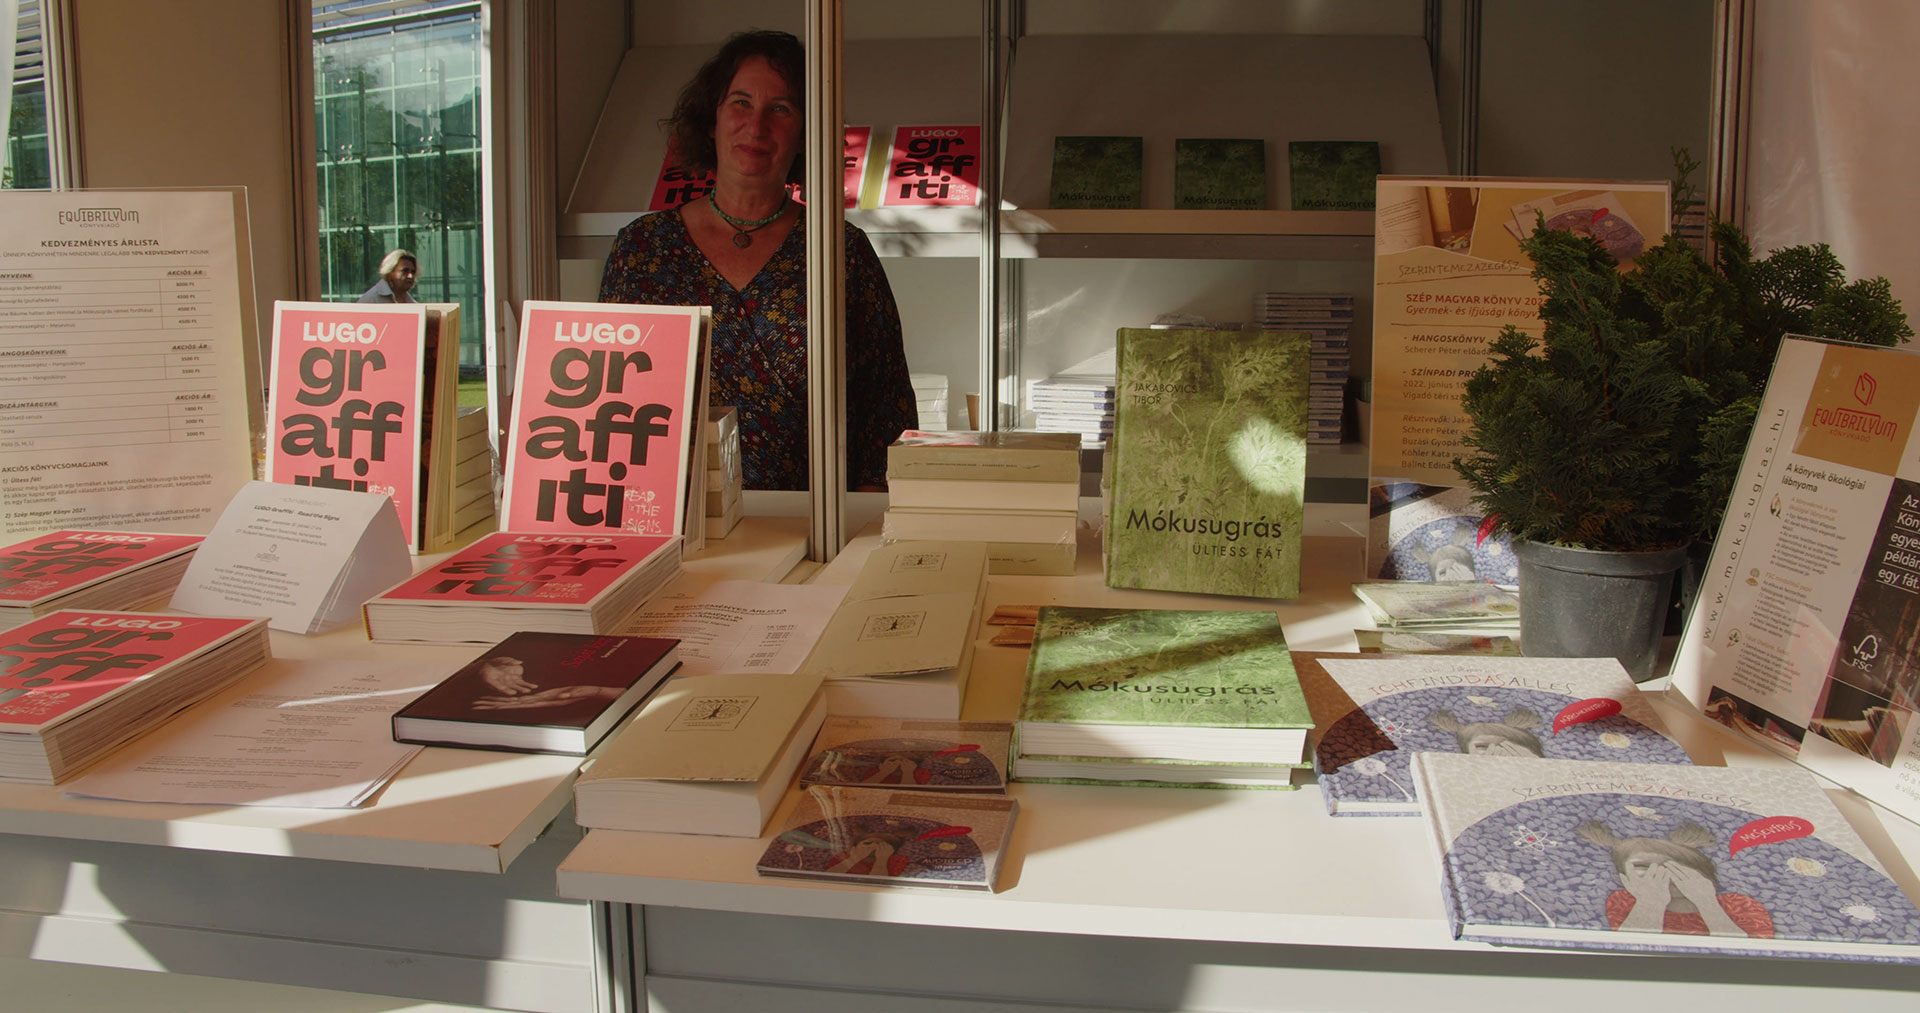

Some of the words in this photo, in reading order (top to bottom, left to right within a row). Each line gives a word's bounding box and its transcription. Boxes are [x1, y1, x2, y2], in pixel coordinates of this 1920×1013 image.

[905, 137, 964, 159] gr
[894, 154, 976, 177] aff
[41, 238, 118, 248] KEDVEZMÉNYES
[121, 237, 160, 246] ÁRLISTA
[1406, 291, 1433, 304] SZÉP
[1435, 294, 1481, 305] MAGYAR
[1483, 293, 1521, 306] KÖNYV
[1406, 305, 1452, 317] Gyermek-
[1455, 306, 1466, 316] és
[1468, 306, 1506, 319] ifjúsági
[1508, 307, 1537, 319] könyv
[1412, 333, 1486, 344] HANGOSKÖNYV
[1404, 345, 1436, 354] Scherer
[1438, 346, 1460, 355] Péter
[295, 347, 387, 407] gr
[544, 347, 653, 409] gr
[1411, 367, 1456, 377] SZÍNPADI
[1134, 382, 1198, 395] JAKABOVICS
[1403, 380, 1426, 388] 2022.
[1427, 380, 1453, 390] június
[1133, 394, 1162, 406] TIBOR
[1403, 391, 1432, 401] Vigadó
[1433, 391, 1449, 400] téri
[1402, 414, 1450, 424] Résztvevők:
[280, 398, 405, 462] aff
[525, 400, 673, 466] aff
[1402, 425, 1434, 434] Scherer
[1436, 426, 1459, 435] Péter
[1402, 437, 1429, 446] Buzási
[1431, 437, 1460, 447] Gyopár
[1402, 449, 1429, 458] Köhler
[1431, 450, 1450, 458] Kata
[2, 464, 30, 473] AKCIÓS
[31, 461, 109, 471] KÖNYVCSOMAGJAINK
[1401, 460, 1426, 469] Bálint
[1428, 461, 1451, 469] Edina
[1786, 463, 1793, 472] A
[1794, 464, 1827, 482] könyvek
[1827, 472, 1867, 491] ökológiai
[1781, 475, 1819, 494] lábnyoma
[536, 461, 628, 529] iti
[624, 490, 656, 502] READ
[1902, 494, 1919, 509] Az
[635, 505, 660, 517] THE
[1125, 508, 1283, 542] Mókusugrás
[1897, 511, 1920, 533] Kön
[1192, 543, 1248, 558] ÜLTESS
[1256, 546, 1283, 560] FÁT
[1878, 568, 1900, 585] egy
[1901, 572, 1920, 590] fát.
[1851, 657, 1873, 674] FSC
[1049, 677, 1277, 697] Mókusugrás
[1149, 697, 1229, 706] ÜLTESS
[1243, 698, 1281, 706] FÁT
